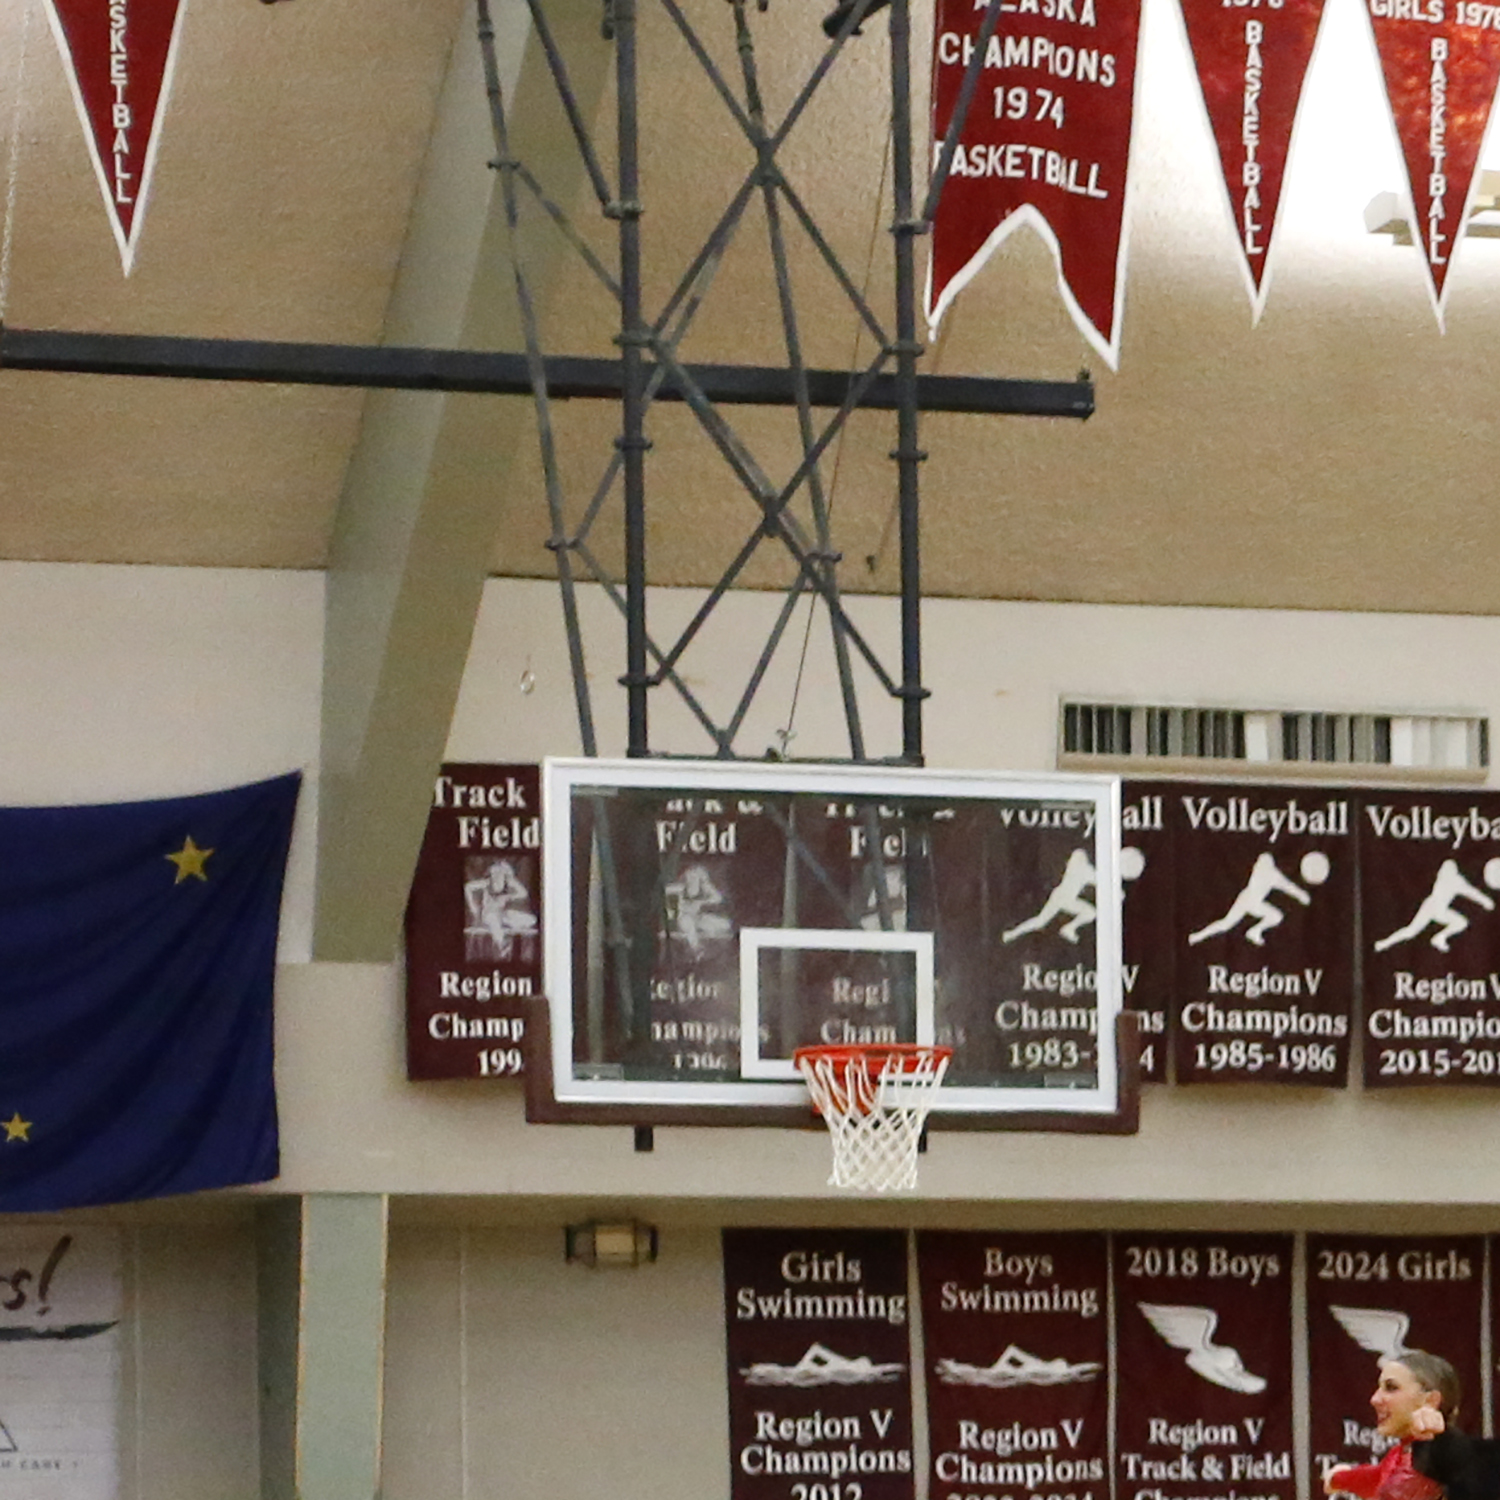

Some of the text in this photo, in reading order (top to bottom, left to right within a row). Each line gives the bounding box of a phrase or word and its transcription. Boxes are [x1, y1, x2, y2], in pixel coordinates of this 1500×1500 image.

[938, 32, 1116, 87] CHAMPIONS
[993, 86, 1065, 129] 1974
[1243, 20, 1264, 255] BASKETBALL
[434, 777, 526, 808] Track
[457, 817, 540, 849] Field
[1184, 797, 1348, 842] Volleyball
[440, 972, 532, 999] Region
[1208, 966, 1300, 1000] Region
[1395, 973, 1488, 1006] Region
[1181, 1003, 1348, 1038] Champions
[1195, 1043, 1337, 1072] 1985-1986
[781, 1251, 862, 1283] Girls
[984, 1249, 1053, 1283] Boys
[1127, 1247, 1280, 1285] 2018 Boys
[1317, 1250, 1472, 1281] 2024 Girls
[737, 1288, 906, 1323] Swimming
[940, 1283, 1099, 1317] Swimming
[756, 1409, 894, 1446] Region V
[959, 1418, 1084, 1454] Region V
[1149, 1419, 1238, 1452] Region
[740, 1445, 912, 1478] Champions
[935, 1453, 1103, 1486] Champions
[1122, 1453, 1195, 1481] Track
[1200, 1455, 1223, 1480] &
[1230, 1451, 1290, 1479] Field
